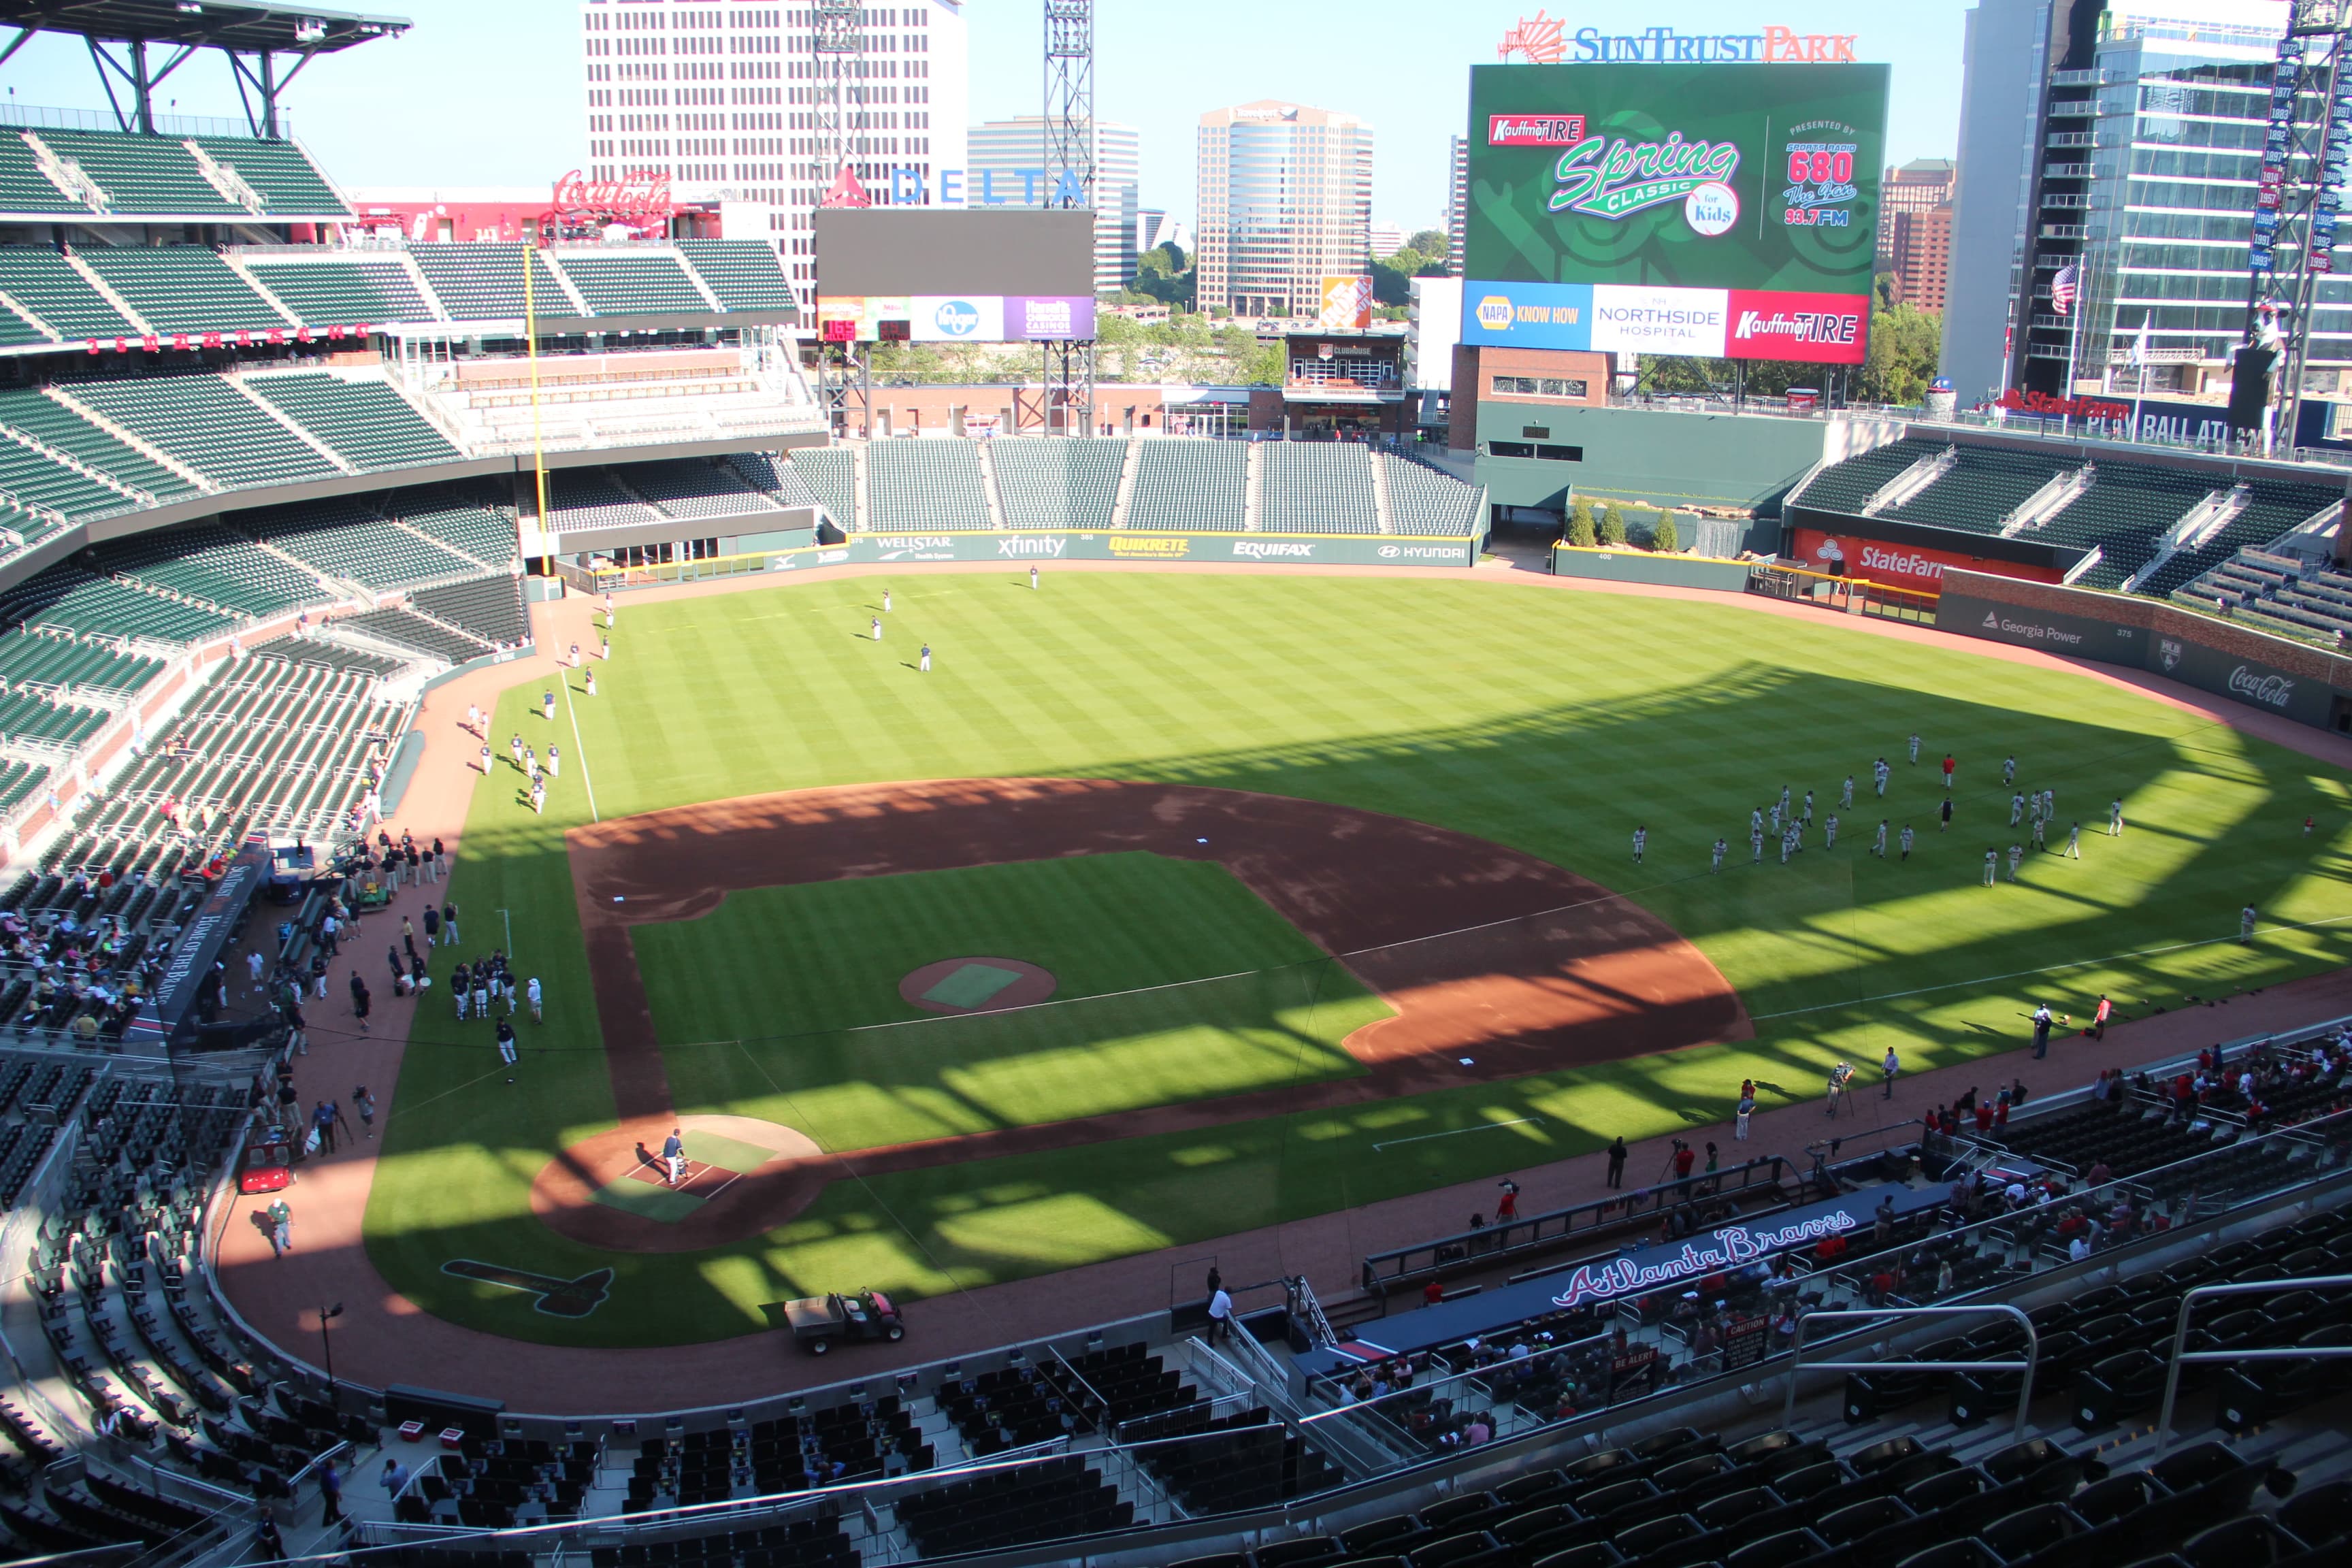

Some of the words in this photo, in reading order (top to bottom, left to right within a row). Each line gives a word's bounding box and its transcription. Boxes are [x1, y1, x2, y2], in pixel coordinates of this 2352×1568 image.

[1761, 25, 1858, 62] PARK
[2281, 43, 2298, 55] 1872
[2277, 65, 2295, 77] 1874
[2274, 86, 2291, 98] 1877
[2271, 108, 2289, 120] 1883
[2332, 105, 2349, 118] 1891
[1790, 120, 1840, 135] PRESENTED
[1842, 125, 1855, 135] BY
[2329, 127, 2347, 140] 1893
[2268, 129, 2285, 141] 1892
[1786, 144, 1825, 152] SPORTS
[1827, 144, 1857, 152] RADIO
[2266, 150, 2283, 162] 1897
[2325, 149, 2344, 161] 1898
[1549, 131, 1739, 211] Spring
[1787, 150, 1852, 185] 680
[2262, 171, 2278, 182] 1914
[2322, 171, 2340, 183] 1948
[892, 169, 1085, 204] DELTA
[1783, 185, 1815, 205] The
[1818, 181, 1856, 200] Fan
[1607, 182, 1690, 211] CLASSIC
[1705, 194, 1718, 203] for
[2259, 192, 2275, 204] 1957
[2319, 192, 2337, 204] 1958
[1695, 206, 1731, 223] Kids
[2256, 213, 2274, 225] 1969
[2316, 214, 2334, 225] 1982
[2254, 233, 2270, 245] 1991
[2313, 235, 2330, 247] 1992
[2309, 256, 2327, 268] 1995
[1325, 281, 1346, 301] THE
[1321, 276, 1370, 327] HOME
[937, 301, 979, 334] Kroger
[1482, 304, 1509, 321] NAPA
[1517, 306, 1549, 323] KNOW
[1552, 307, 1578, 324] HOW
[1599, 308, 1720, 325] NORTHSIDE
[1026, 321, 1071, 329] CASINOS
[1620, 326, 1696, 338] HOSPITAL
[2144, 414, 2188, 444] BALL
[877, 537, 951, 551] WELLSTAR
[998, 534, 1066, 558] xfinity
[1109, 536, 1188, 553] QUIKRETE
[1232, 542, 1312, 558] EQUIFAX
[1404, 546, 1465, 559] HYUNDAI
[2002, 619, 2043, 638] Georgia
[2046, 627, 2082, 644] Power
[2117, 629, 2132, 638] 375
[2161, 640, 2180, 653] MLB
[189, 915, 222, 941] HOME
[169, 952, 196, 971] THE
[1552, 1243, 1727, 1307] Atlanta
[1714, 1211, 1856, 1260] Braves
[1731, 1318, 1765, 1334] CAUTION
[1616, 1358, 1627, 1369] BE
[1628, 1350, 1654, 1364] ALERT
